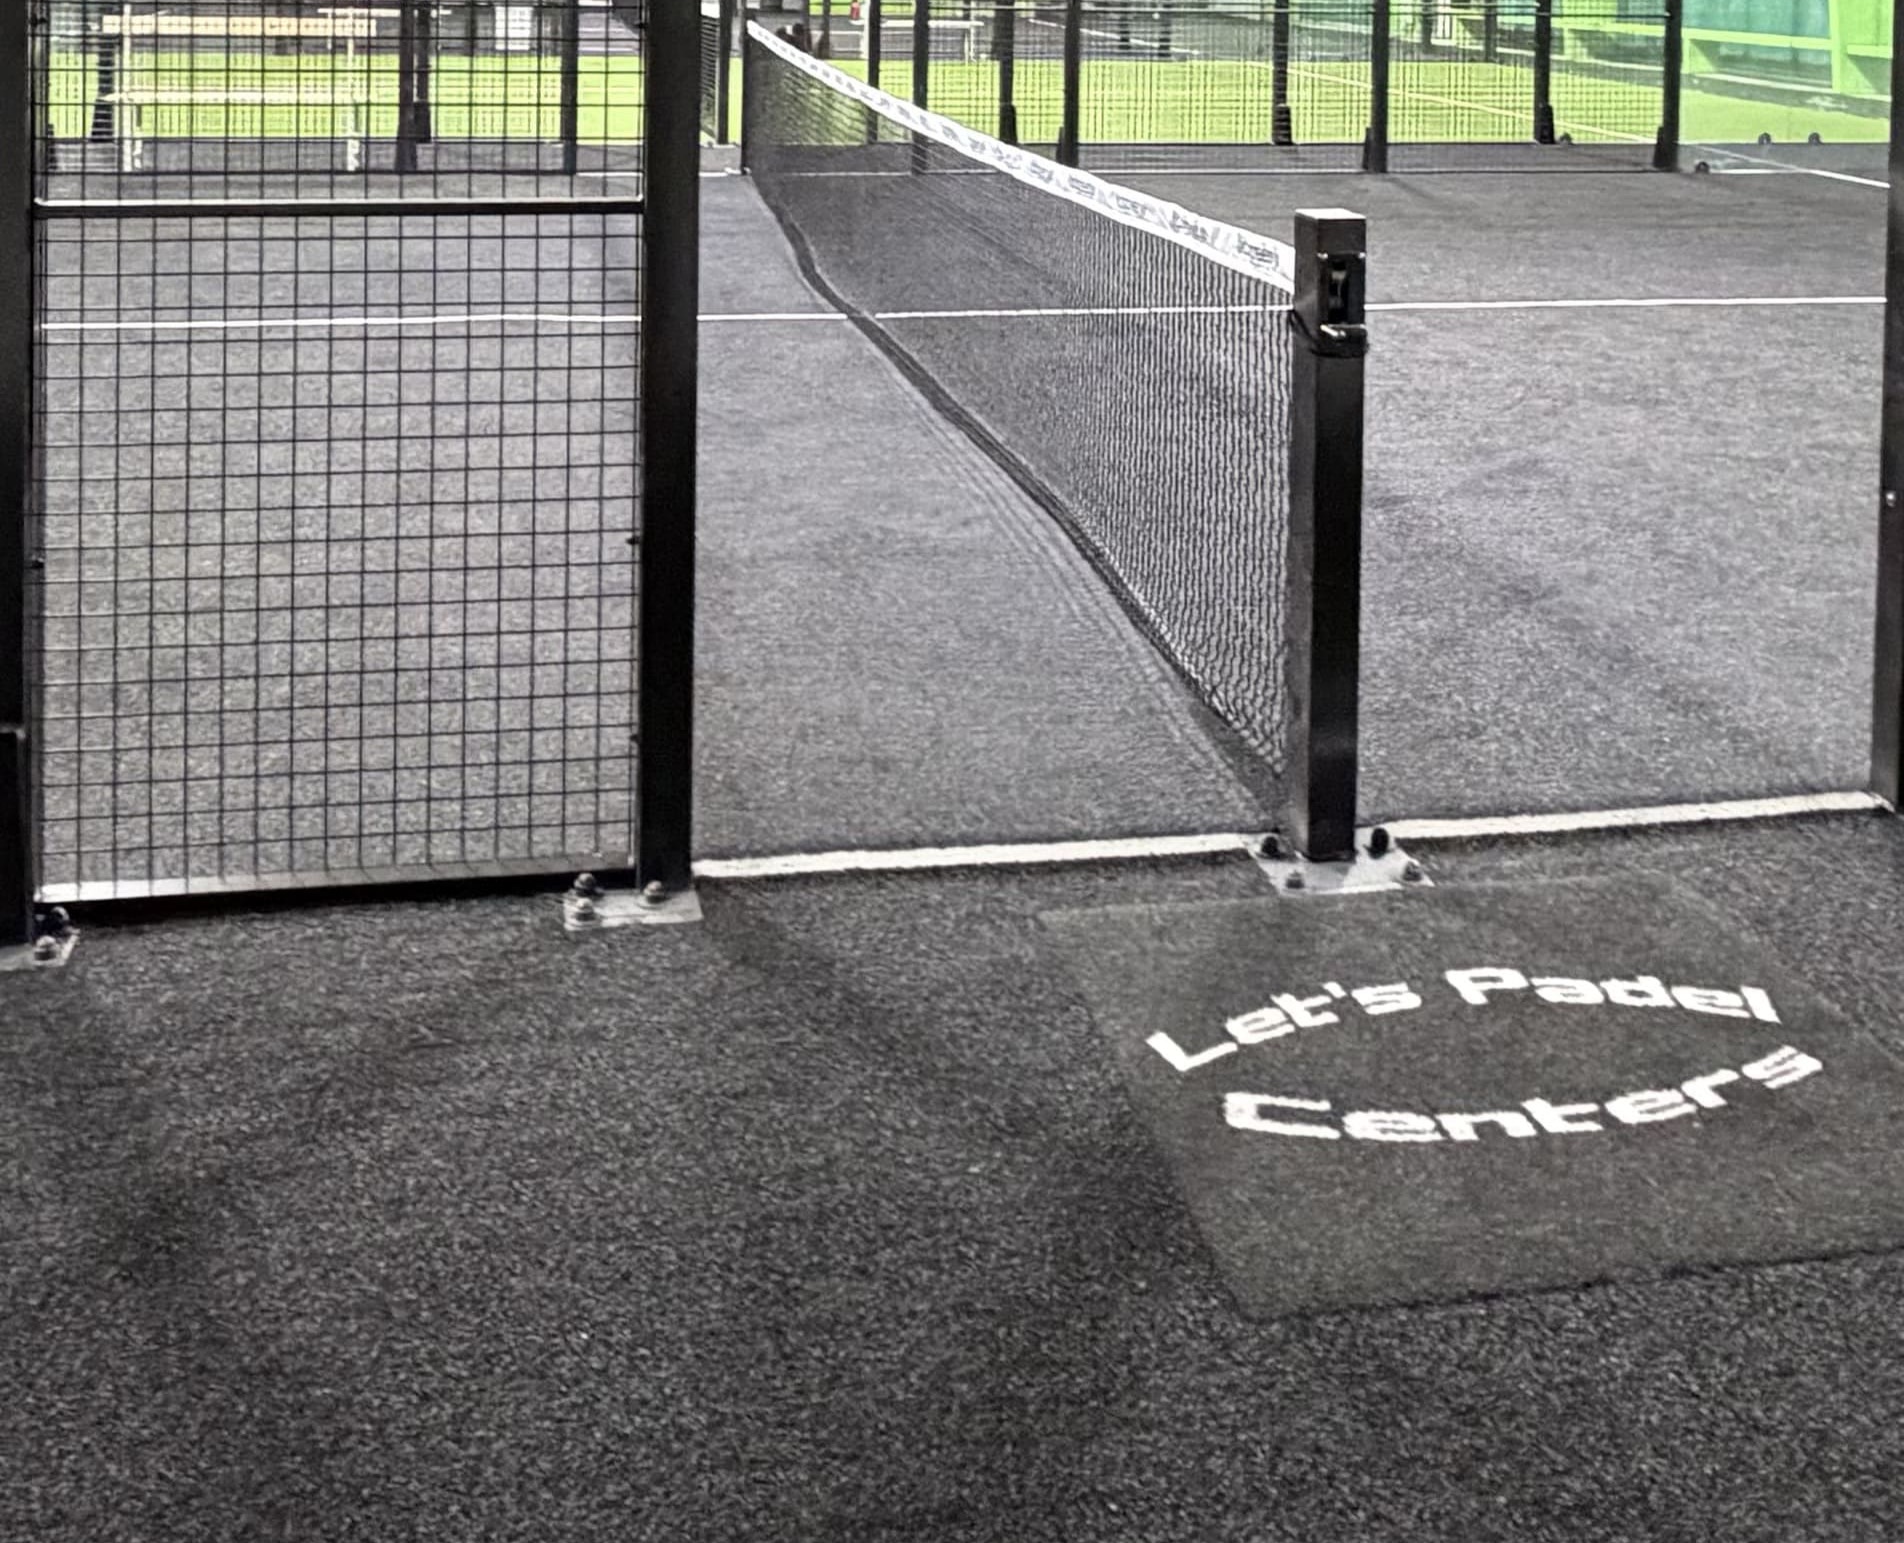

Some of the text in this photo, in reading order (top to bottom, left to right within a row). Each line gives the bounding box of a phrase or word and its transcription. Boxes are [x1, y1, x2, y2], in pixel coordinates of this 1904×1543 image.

[1145, 966, 1780, 1073] Let's Padel
[1223, 1045, 1824, 1143] Centers
